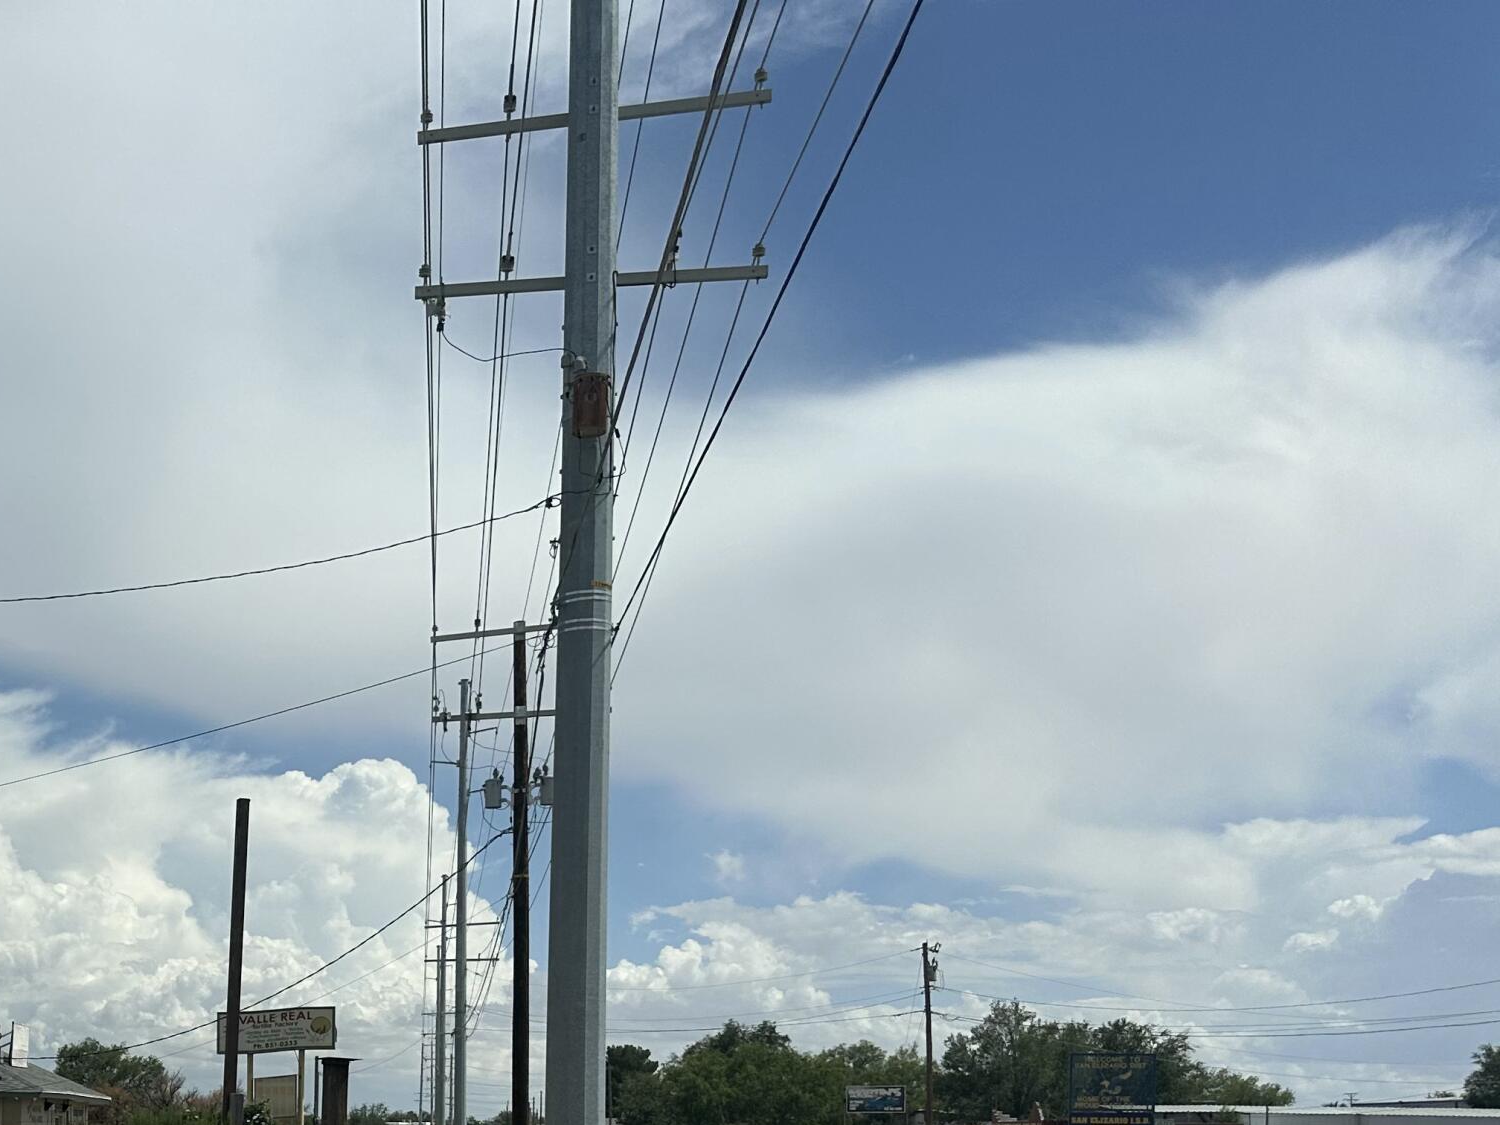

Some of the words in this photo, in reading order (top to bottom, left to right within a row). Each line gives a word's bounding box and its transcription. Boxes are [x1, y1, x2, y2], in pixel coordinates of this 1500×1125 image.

[239, 1013, 276, 1025] VALLE
[280, 1011, 313, 1021] REAL
[1071, 1116, 1088, 1124] SAN
[1090, 1116, 1129, 1124] ELIZARIO
